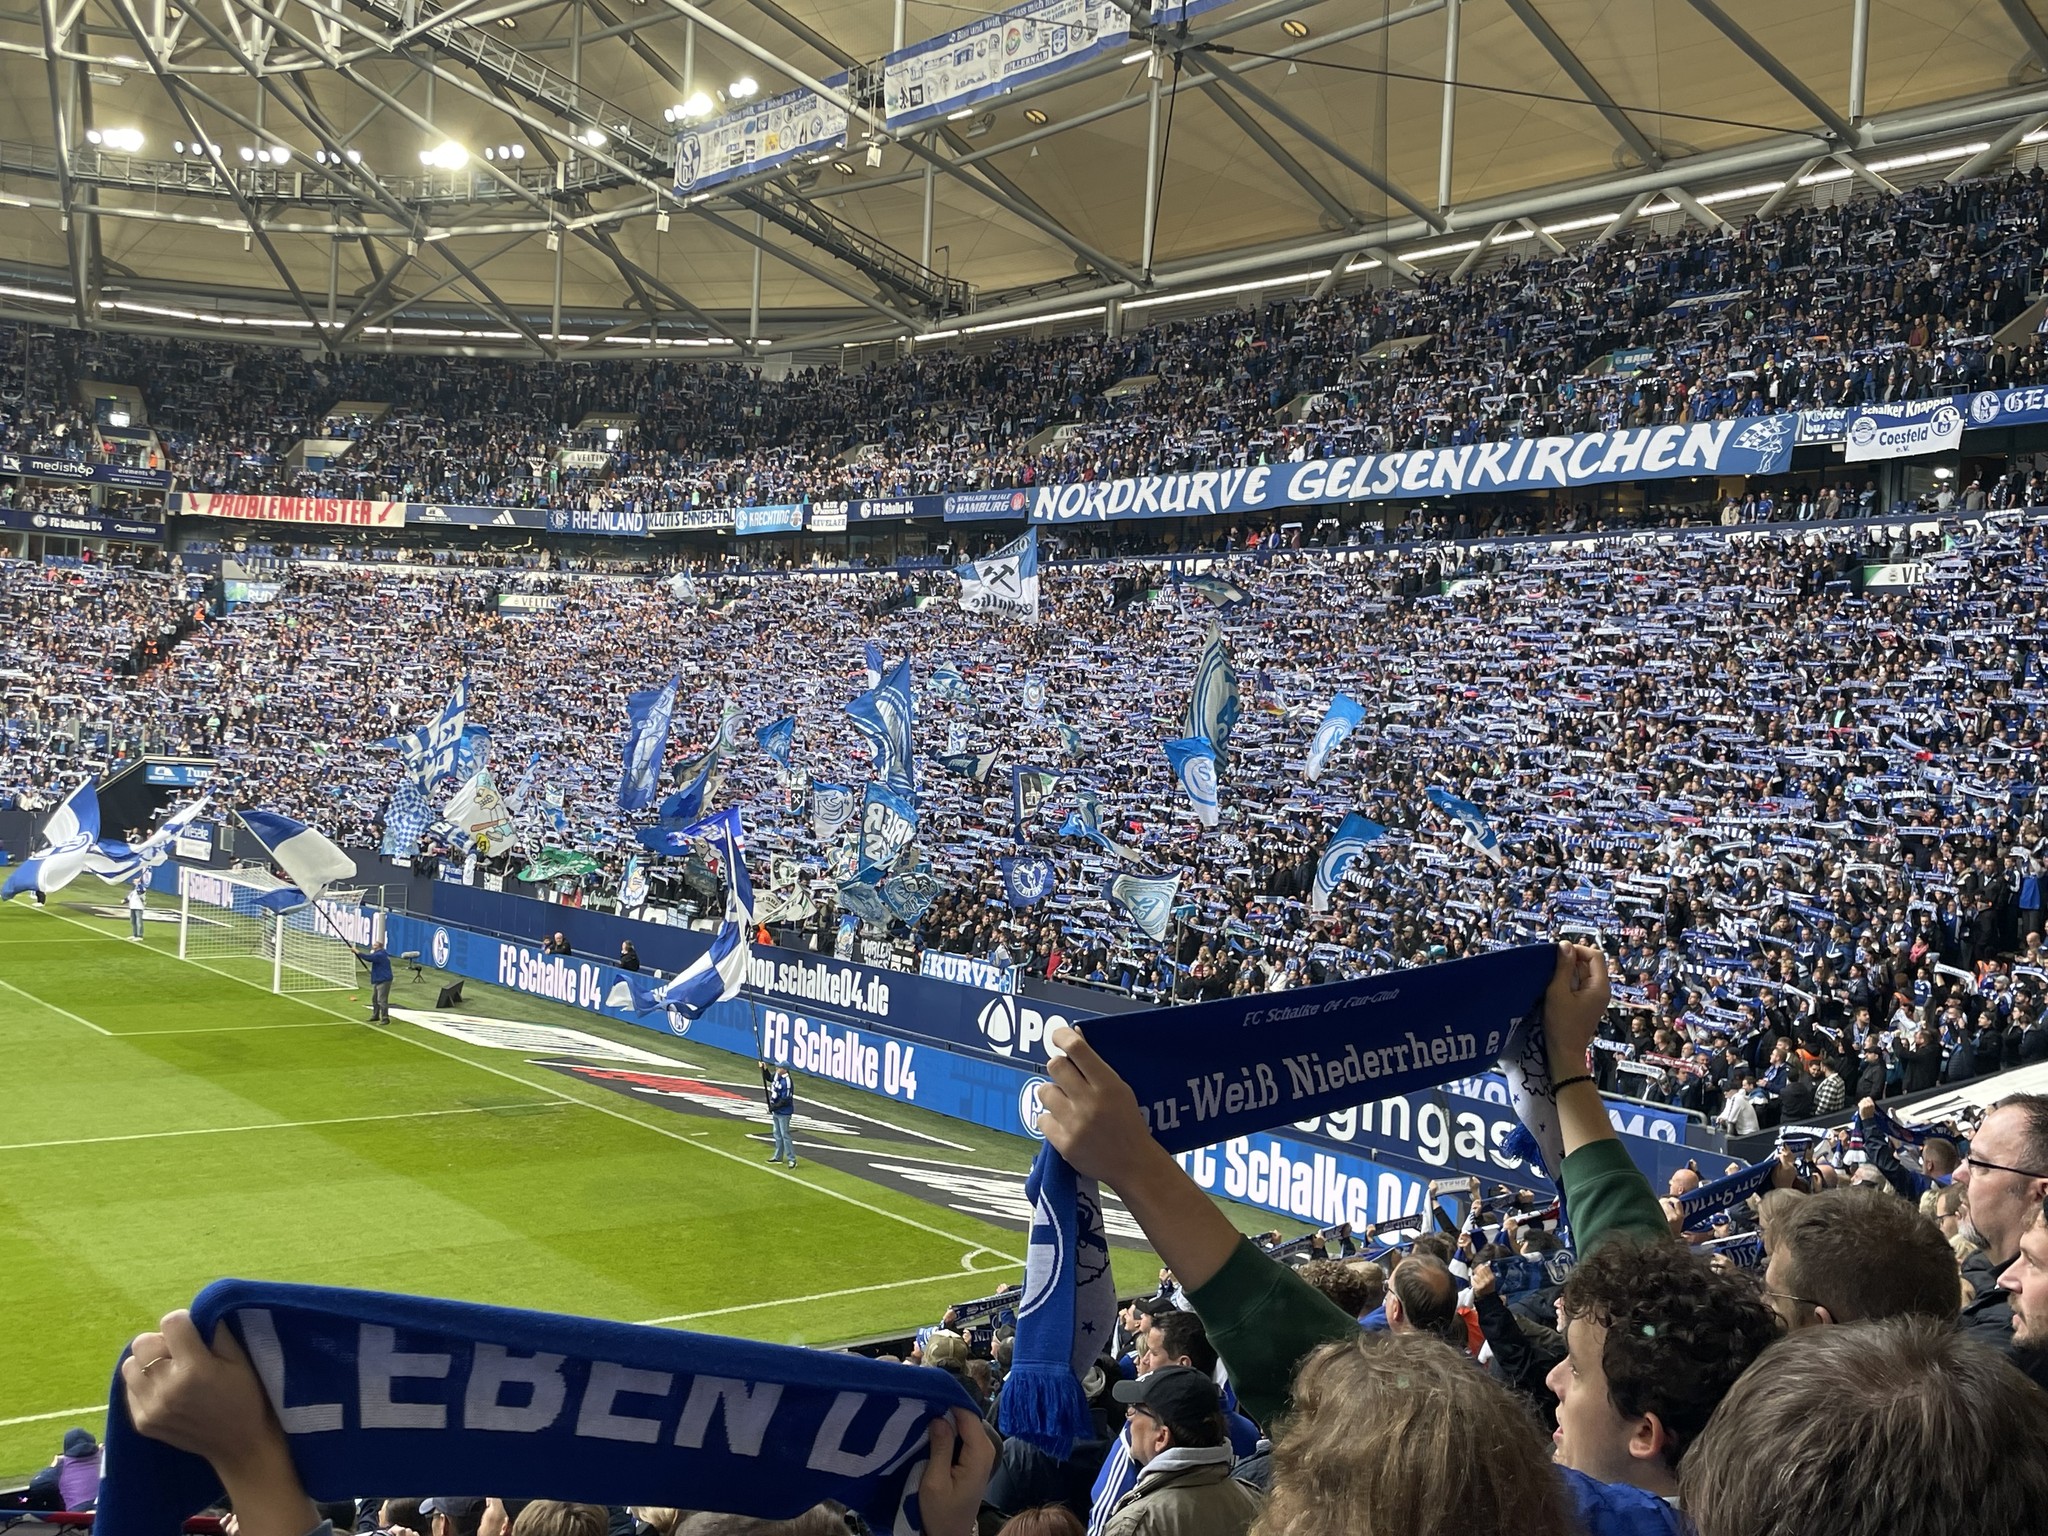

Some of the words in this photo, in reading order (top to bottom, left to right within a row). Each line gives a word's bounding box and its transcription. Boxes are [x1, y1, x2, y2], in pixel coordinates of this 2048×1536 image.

[1905, 396, 1954, 419] Knappen
[1879, 426, 1929, 446] Coesfeld
[1895, 445, 1910, 453] e.V.
[32, 460, 95, 477] medishop
[117, 467, 149, 477] elements
[1034, 466, 1272, 521] NORDKURVE
[1288, 419, 1737, 502] GELSENKIRCHEN
[208, 493, 372, 525] PROBLEMFENSTER
[682, 508, 735, 526] ENNEPETAL
[872, 503, 881, 516] FC
[881, 502, 904, 516] Schalke
[904, 500, 915, 515] 04
[956, 500, 1010, 514] HAMBURG
[50, 516, 60, 528] FC
[572, 509, 643, 532] RHEINLAND
[861, 938, 894, 962] MARLER
[499, 942, 517, 988] FC
[518, 949, 577, 1009] Schalke
[579, 963, 602, 1011] 04
[746, 949, 890, 1017] hop.schalke04.de
[930, 952, 1000, 991] KURVE
[1242, 1010, 1264, 1027] FC
[1265, 1003, 1321, 1023] Schalke
[1342, 988, 1400, 1009] Fan-Club
[763, 1009, 790, 1063] FC
[792, 1017, 879, 1090] Schalke
[883, 1040, 917, 1100] 04
[1281, 1025, 1477, 1098] Niederrhein
[1224, 1135, 1368, 1234] Schalke
[238, 1308, 784, 1458] LEBEN
